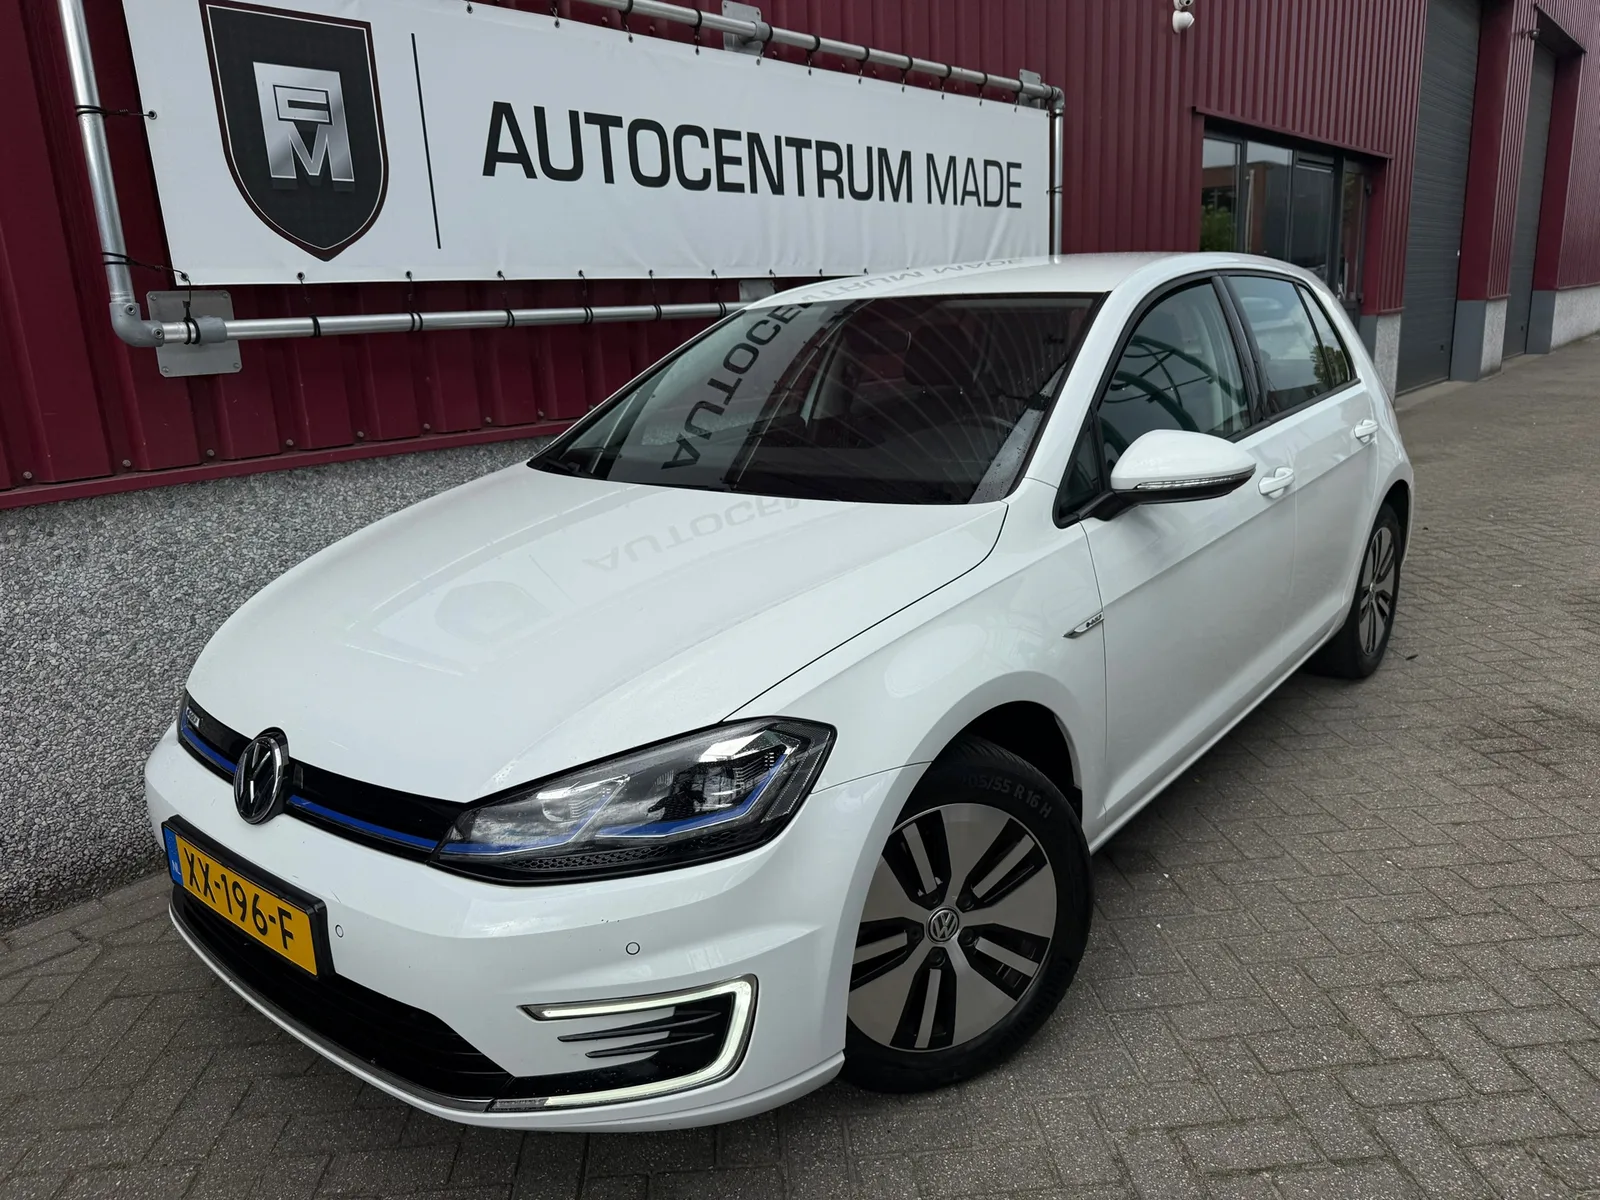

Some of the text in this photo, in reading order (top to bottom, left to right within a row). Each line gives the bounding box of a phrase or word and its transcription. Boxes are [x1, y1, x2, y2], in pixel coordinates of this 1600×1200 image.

[482, 101, 1022, 209] AUTOCENTRUM MADE
[184, 846, 294, 950] XX-196-F
